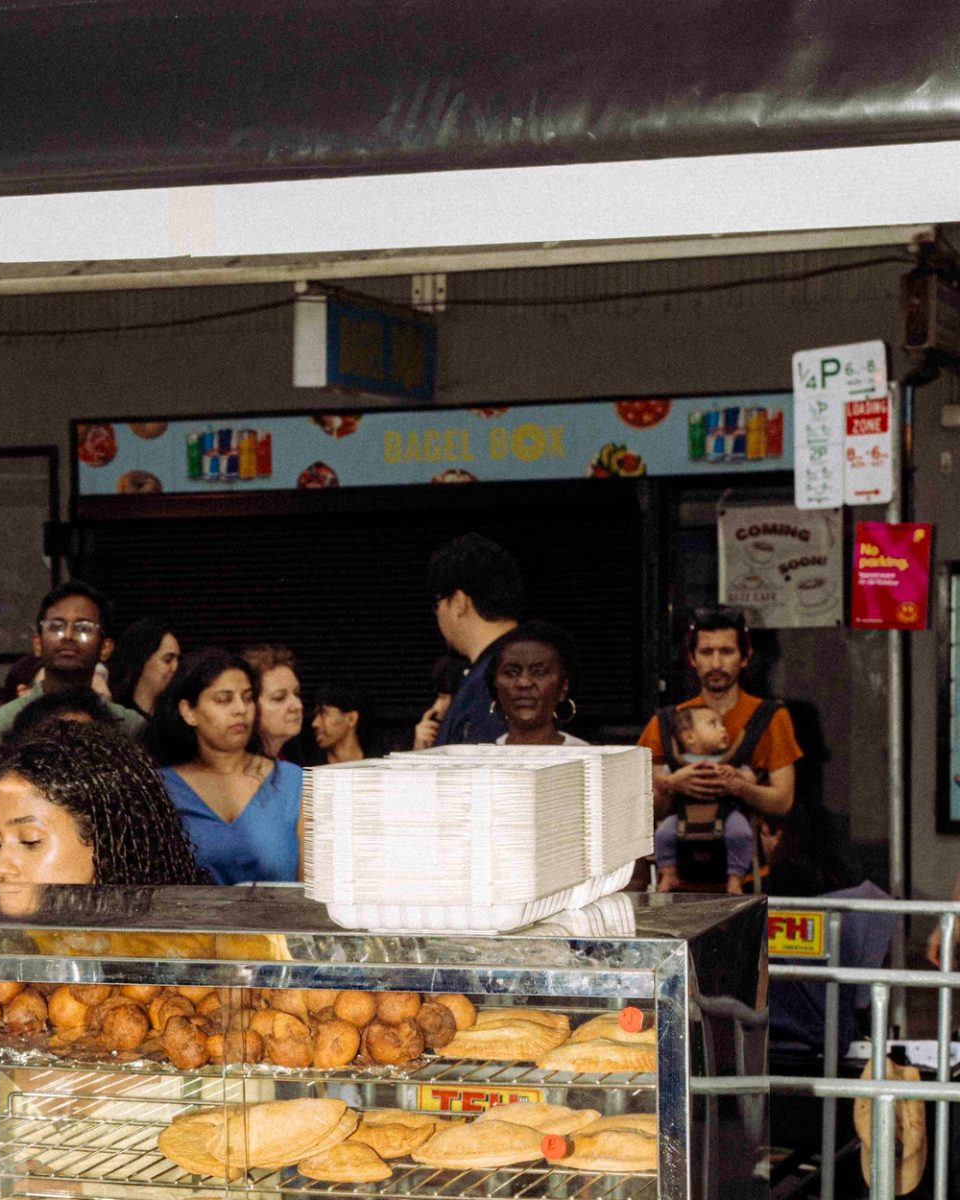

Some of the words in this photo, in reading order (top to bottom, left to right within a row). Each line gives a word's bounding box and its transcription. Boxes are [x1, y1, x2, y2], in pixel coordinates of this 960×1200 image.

[821, 358, 840, 389] P
[852, 417, 882, 434] ZONE
[384, 427, 474, 465] BAGEL
[490, 422, 566, 462] BOX
[736, 523, 810, 542] COMING
[778, 556, 828, 575] SOON!
